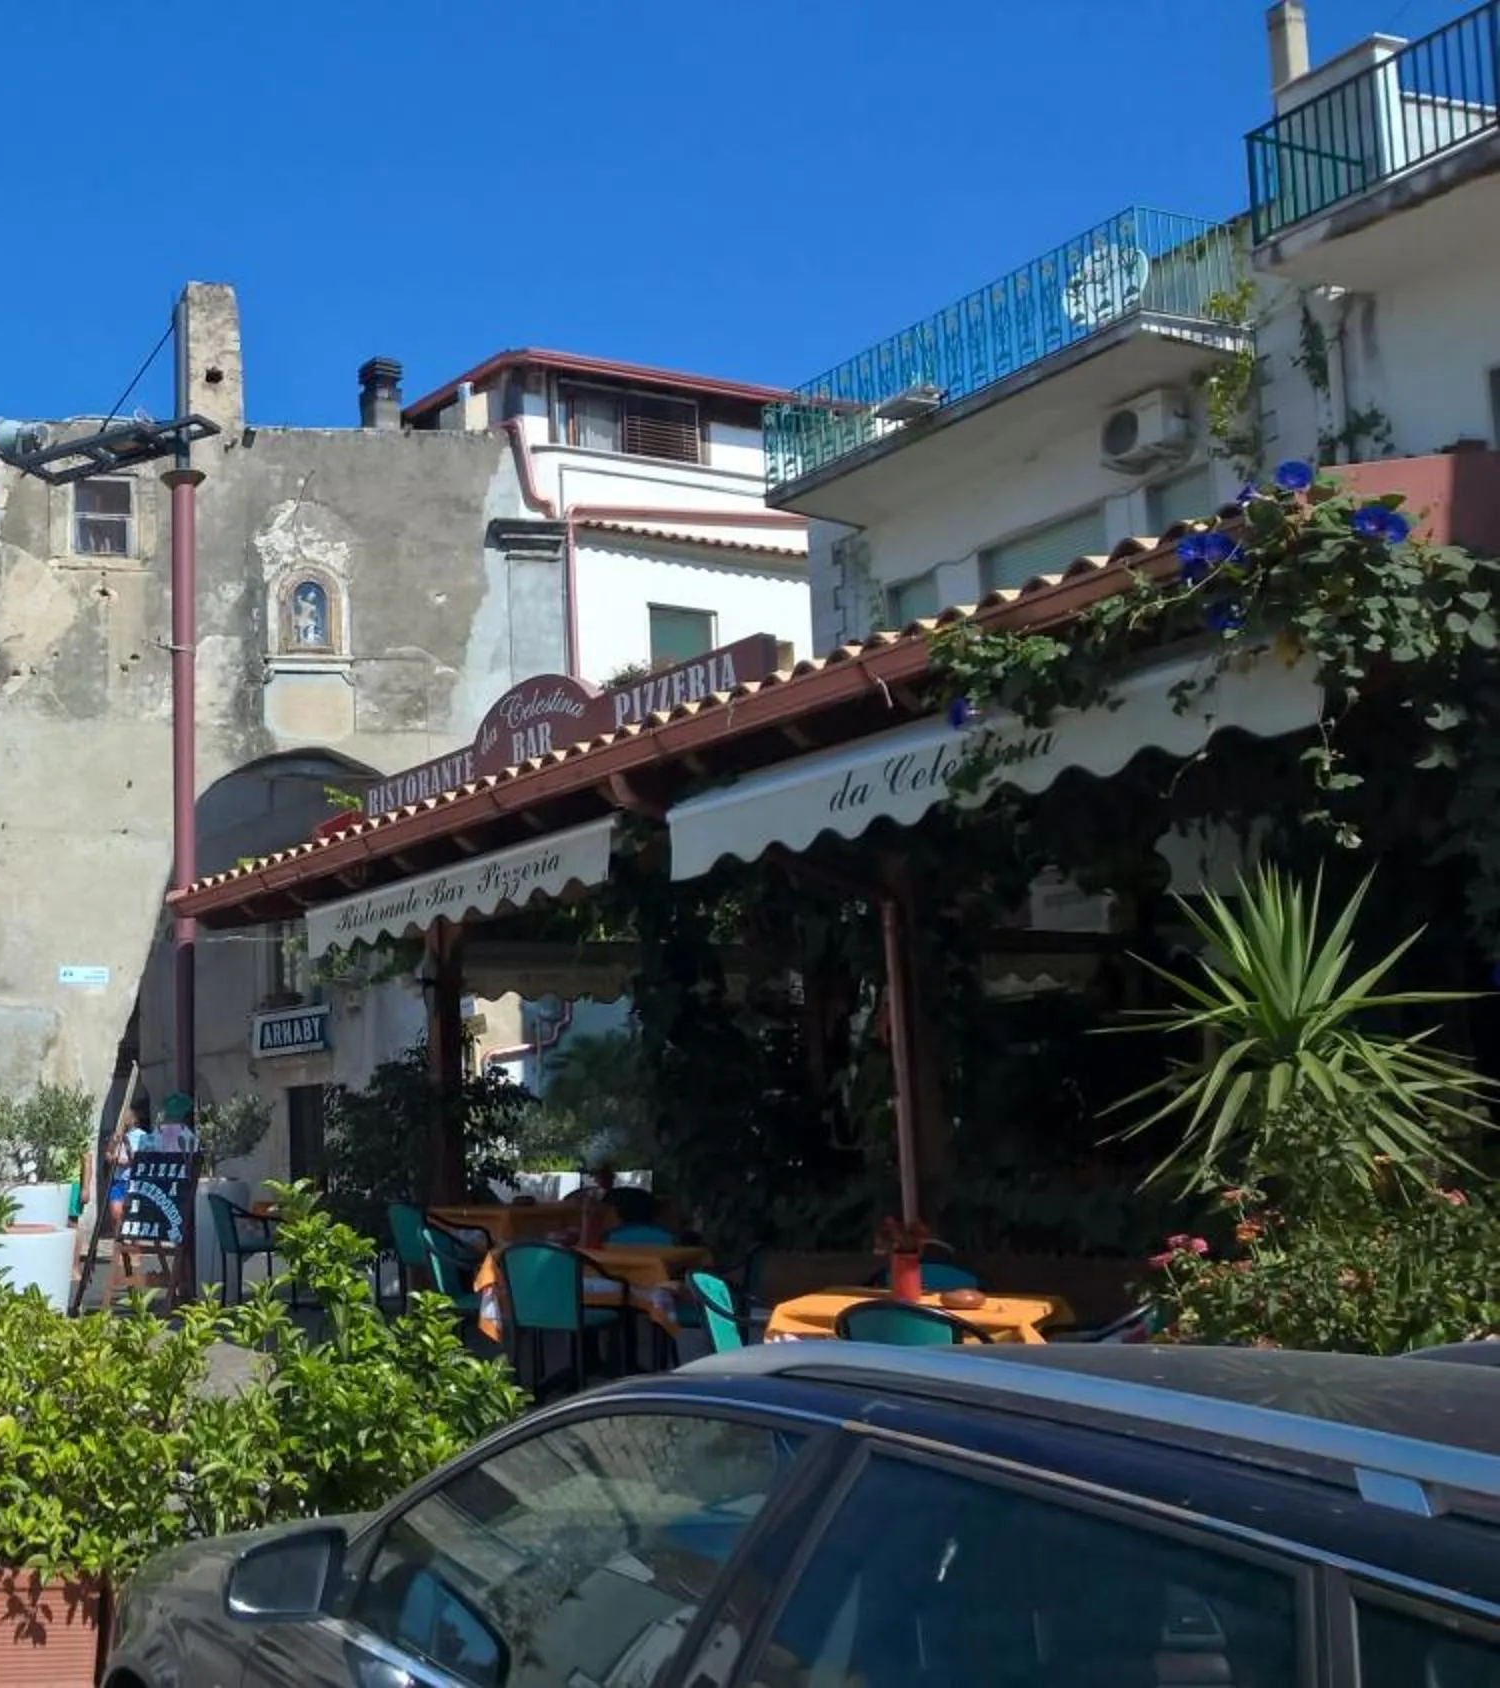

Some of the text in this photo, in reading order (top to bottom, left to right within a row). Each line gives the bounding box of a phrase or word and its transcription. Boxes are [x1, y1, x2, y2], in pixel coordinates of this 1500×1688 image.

[500, 688, 585, 729] Celestina
[614, 653, 737, 730] PIZZERIA
[512, 722, 553, 764] BAR
[368, 751, 475, 817] RISTORANTE
[830, 771, 871, 812] da
[335, 850, 561, 931] Ristorante Bar Pizzeria
[135, 1163, 187, 1178] PIZZA
